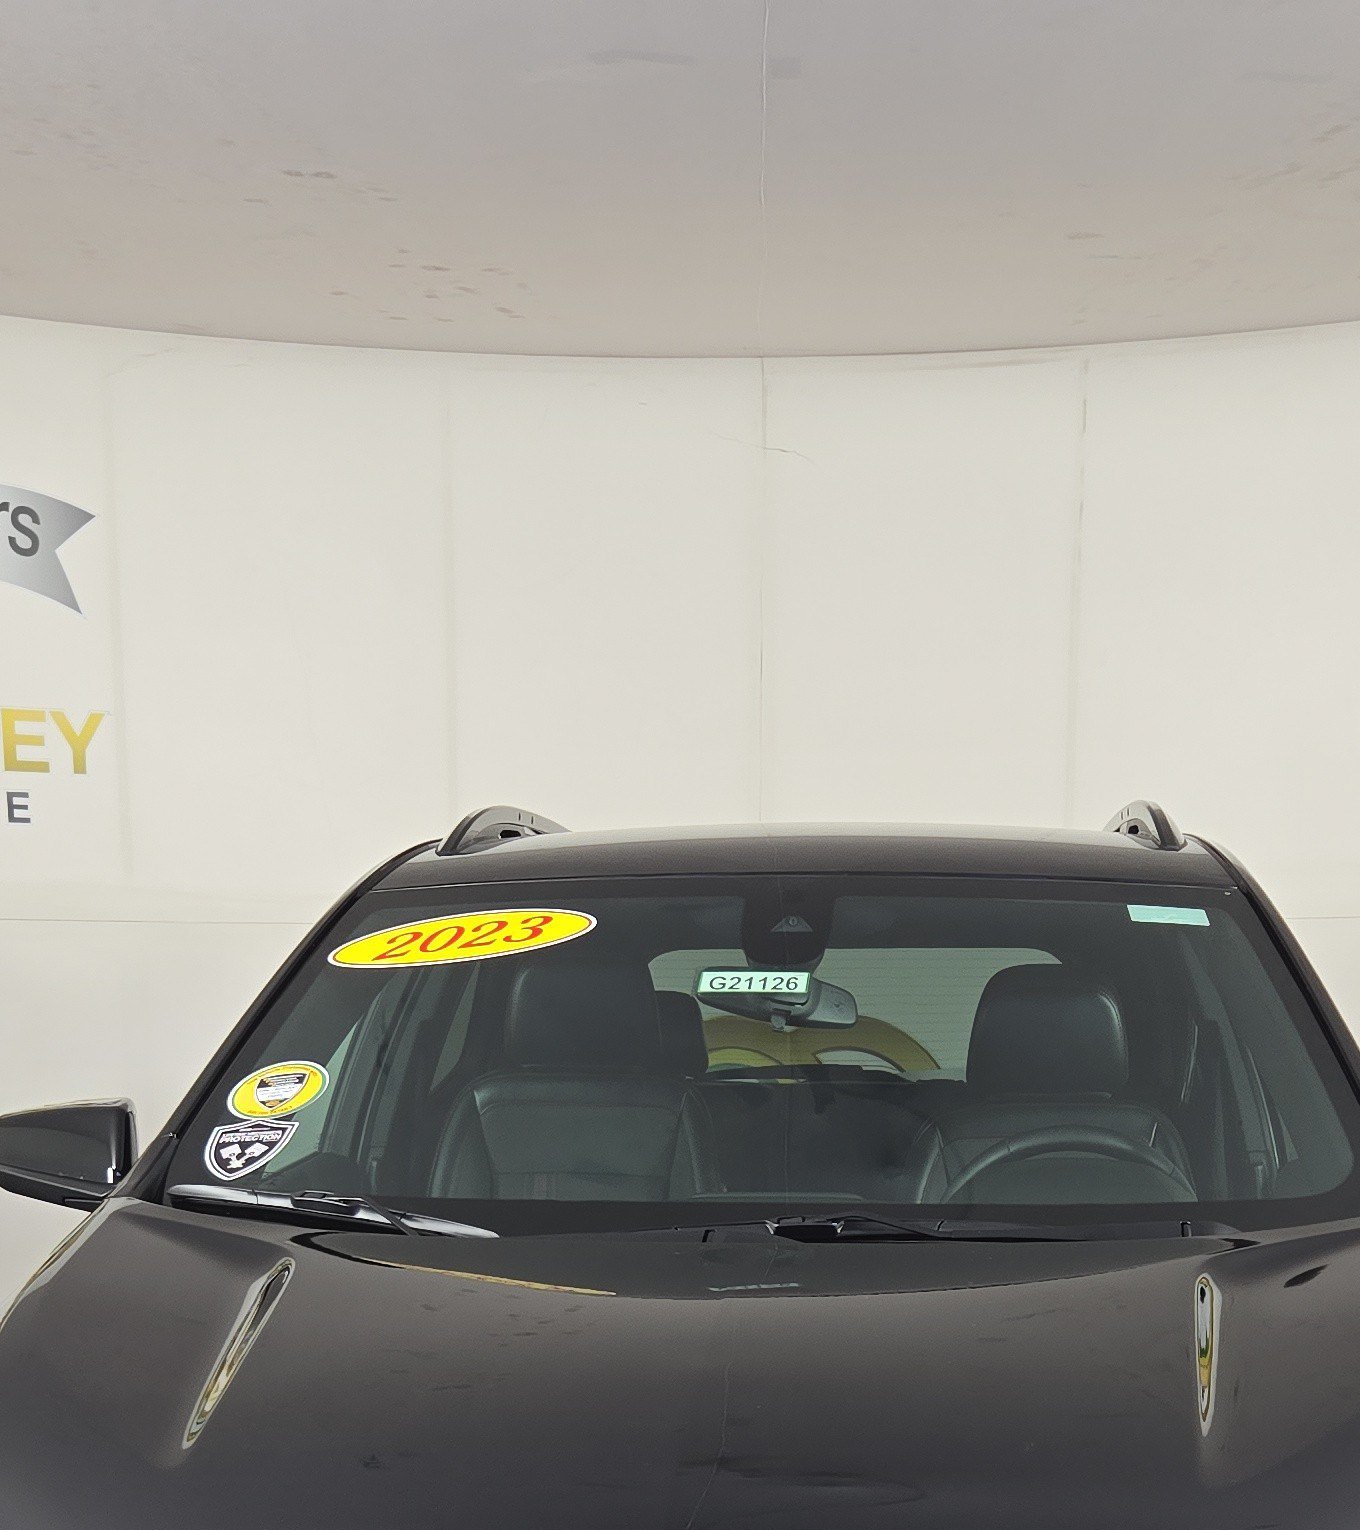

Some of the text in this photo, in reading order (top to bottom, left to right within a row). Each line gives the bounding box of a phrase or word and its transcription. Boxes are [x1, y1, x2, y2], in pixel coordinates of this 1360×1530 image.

[372, 915, 554, 962] 2023
[709, 976, 799, 991] G21126
[218, 1130, 284, 1145] PROTECTION
